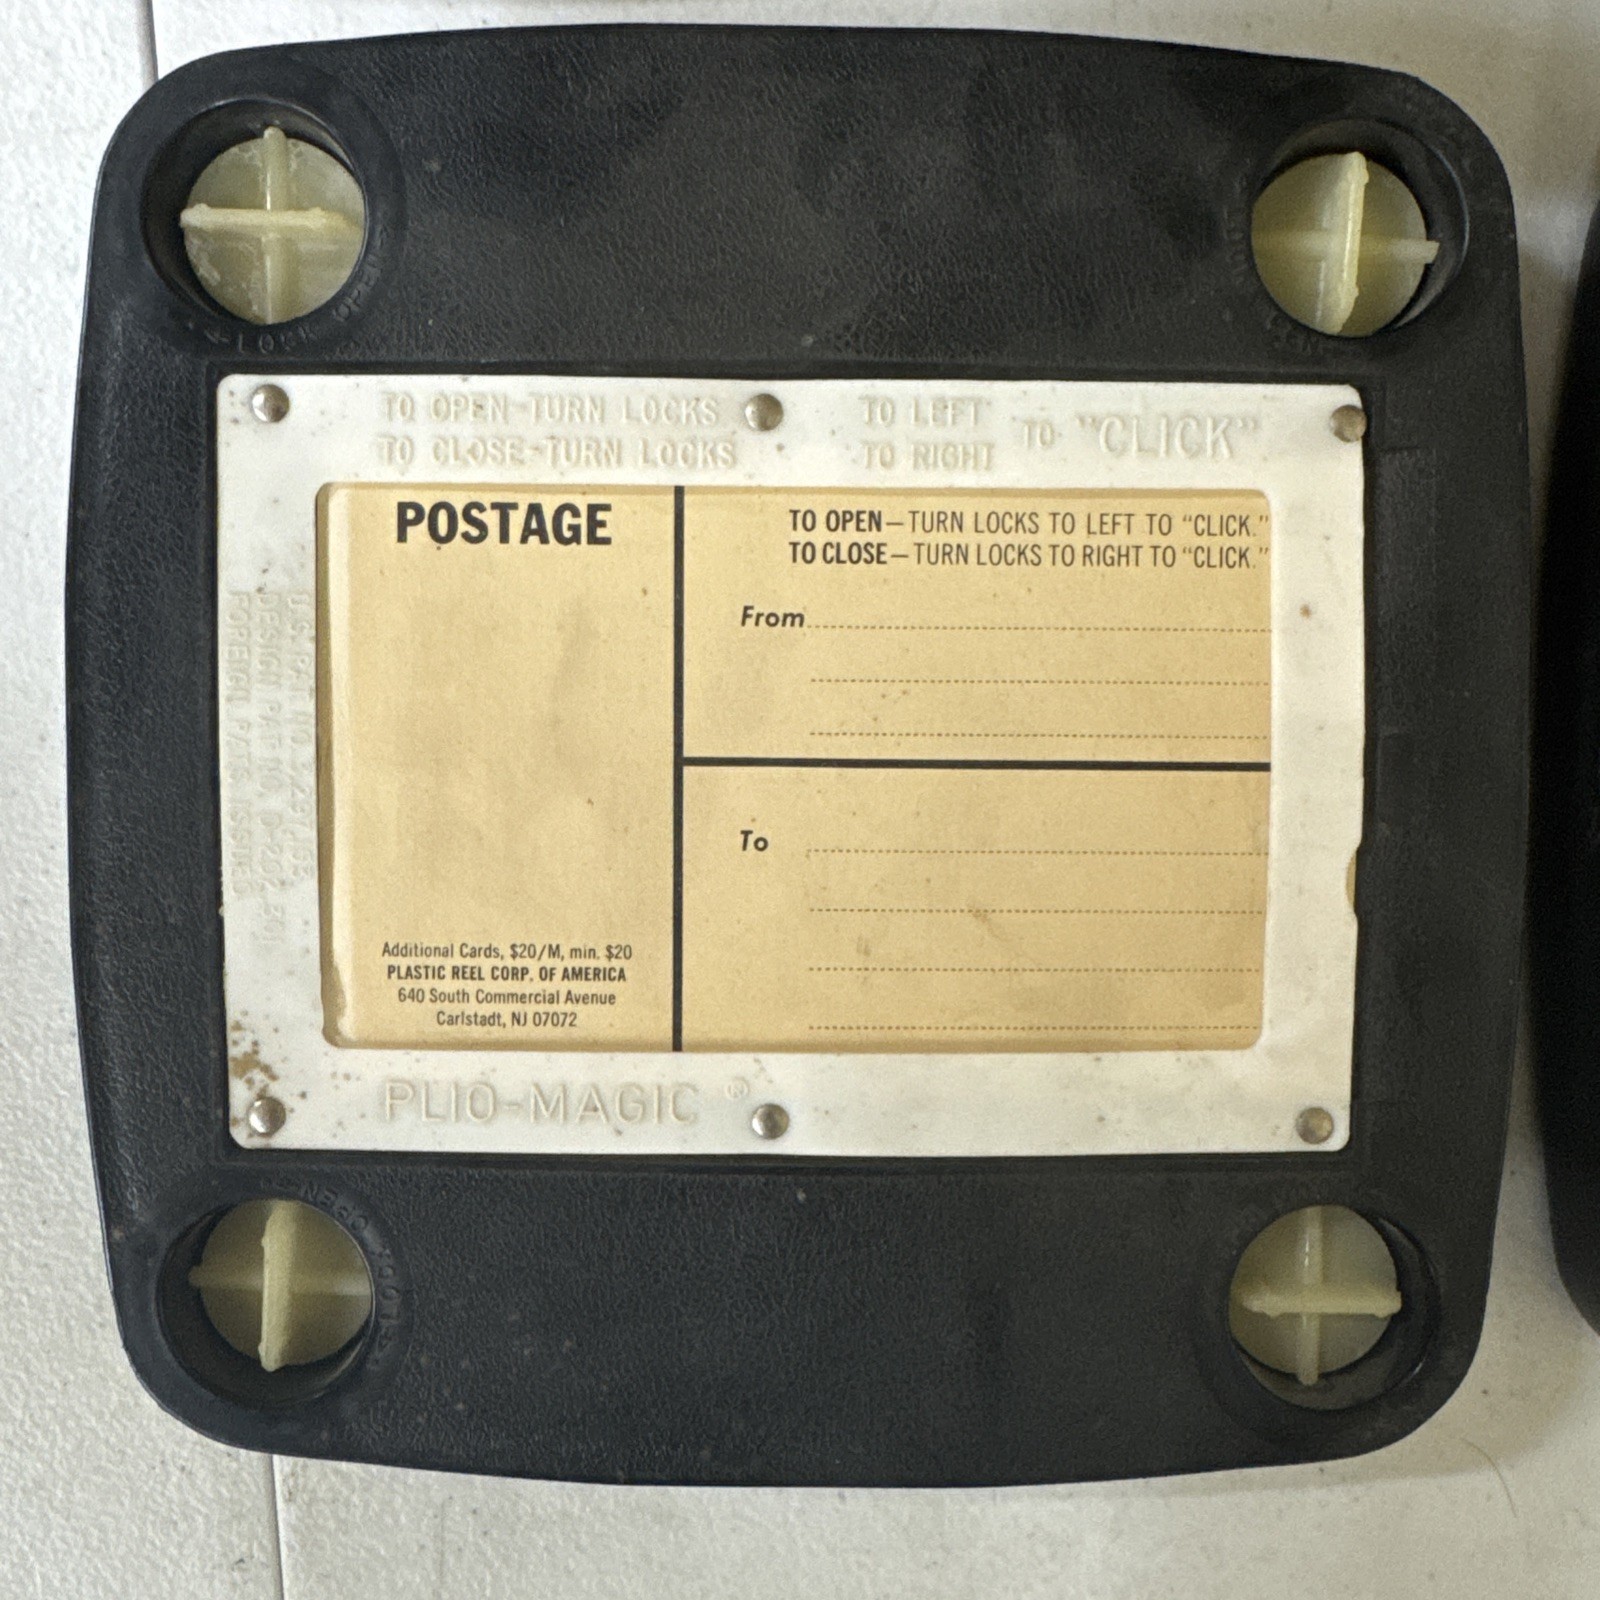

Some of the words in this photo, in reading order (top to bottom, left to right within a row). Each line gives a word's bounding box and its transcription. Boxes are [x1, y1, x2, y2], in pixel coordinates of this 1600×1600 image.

[381, 392, 415, 425] TO
[621, 397, 720, 426] LOCKS
[861, 397, 895, 427] TO
[910, 398, 985, 426] LEFT
[1021, 418, 1055, 449] TO
[379, 436, 414, 467] TO
[638, 440, 737, 470] LOCKS
[862, 441, 896, 470] TO
[912, 441, 995, 472] RIGHT
[396, 500, 613, 546] POSTAGE
[788, 508, 817, 533] TO
[974, 510, 1040, 535] LOCKS
[1048, 511, 1076, 536] TO
[1086, 512, 1135, 536] LEFT
[1145, 513, 1173, 537] TO
[788, 540, 817, 565] TO
[976, 543, 1042, 567] LOCKS
[1048, 543, 1076, 568] TO
[1082, 544, 1144, 568] RIGHT
[1149, 544, 1177, 568] TO
[740, 604, 805, 628] From
[739, 829, 769, 852] To
[381, 941, 454, 958] Additional
[459, 942, 504, 961] Cards,
[509, 942, 565, 962] $20/M,
[569, 944, 600, 960] min.
[605, 944, 633, 962] $20
[387, 964, 446, 981] PLASTIC
[451, 964, 485, 982] REEL
[490, 965, 534, 982] CORP.
[538, 965, 557, 982] OF
[561, 966, 627, 982] AMERICA
[397, 986, 425, 1004] 640
[429, 987, 470, 1004] South
[475, 988, 560, 1005] Commercial
[564, 989, 617, 1006] Avenue
[436, 1010, 506, 1029] Carlstadt,
[511, 1011, 528, 1027] NJ
[532, 1011, 578, 1028] 07072
[384, 1079, 700, 1126] PLIO-MAGIC
